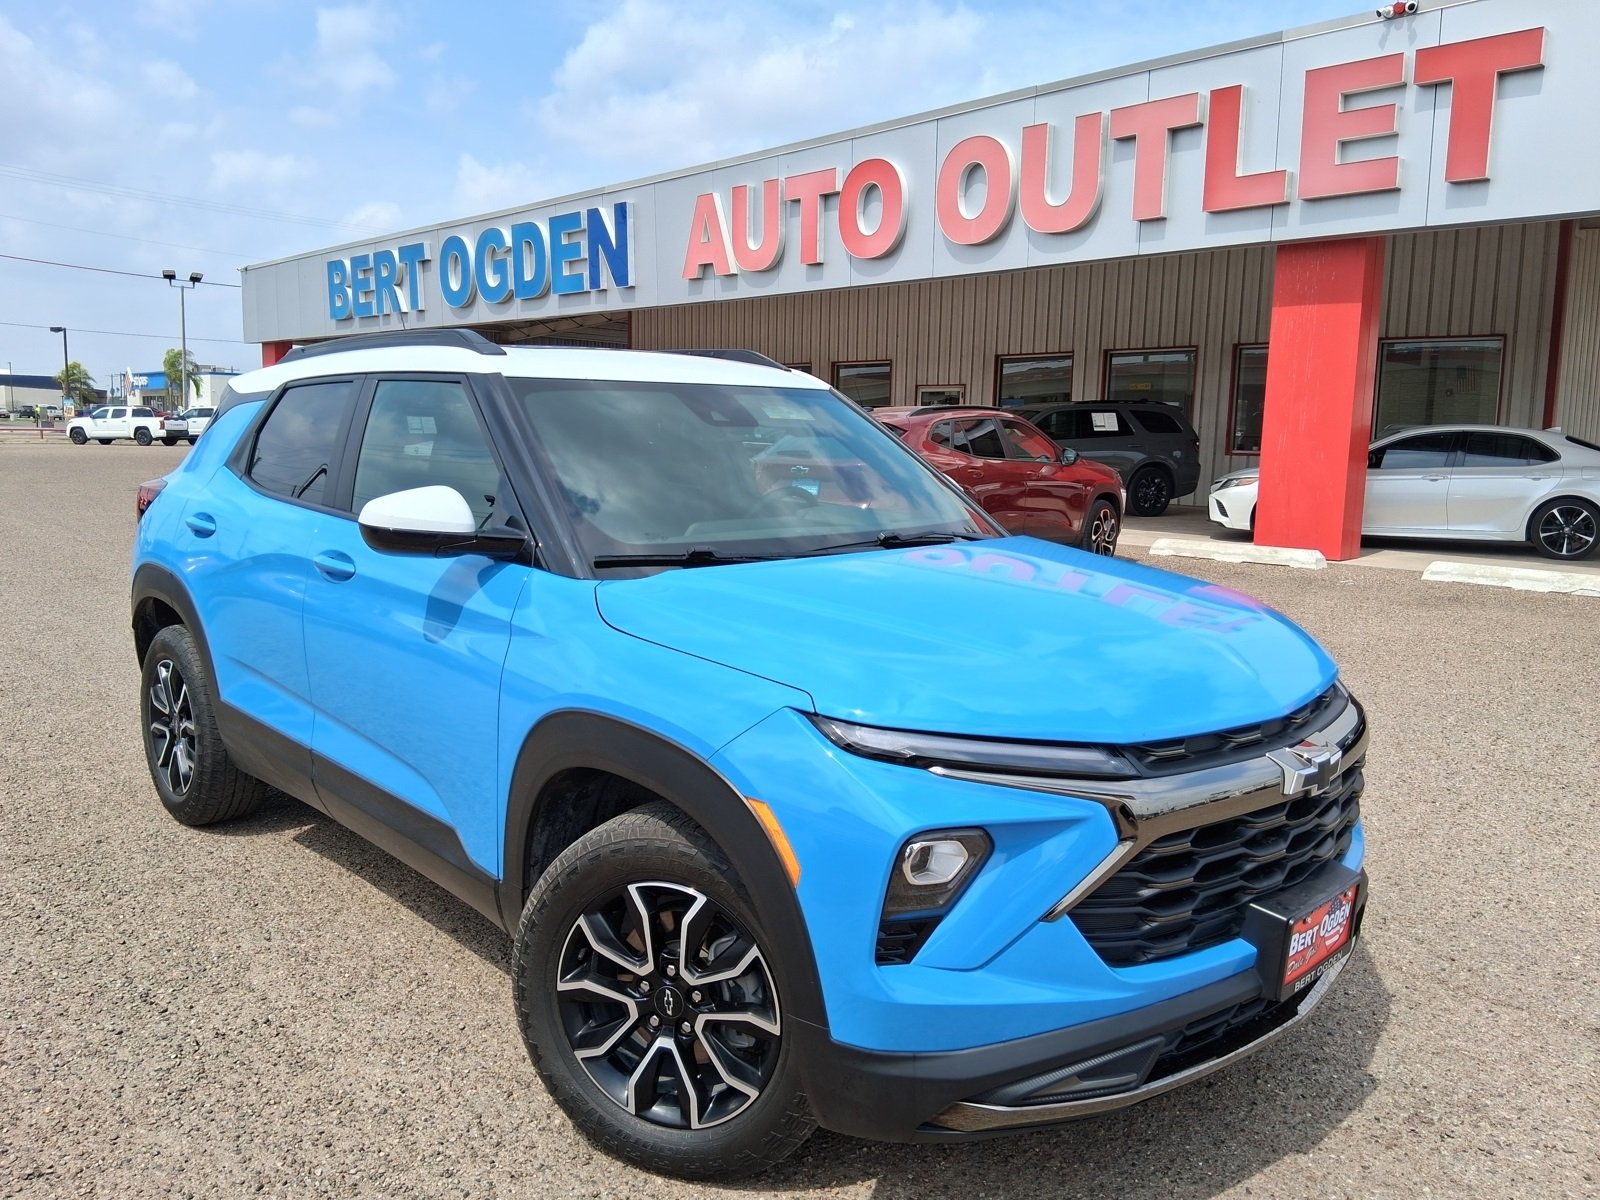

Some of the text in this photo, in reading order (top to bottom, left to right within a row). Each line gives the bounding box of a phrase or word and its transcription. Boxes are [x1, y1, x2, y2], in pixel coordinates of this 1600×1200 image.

[682, 26, 1546, 280] AUTO OUTLET
[327, 202, 634, 320] BERT OGDEN
[1288, 901, 1351, 957] BERT OGDEN
[1294, 951, 1343, 992] BERT OGDEN
